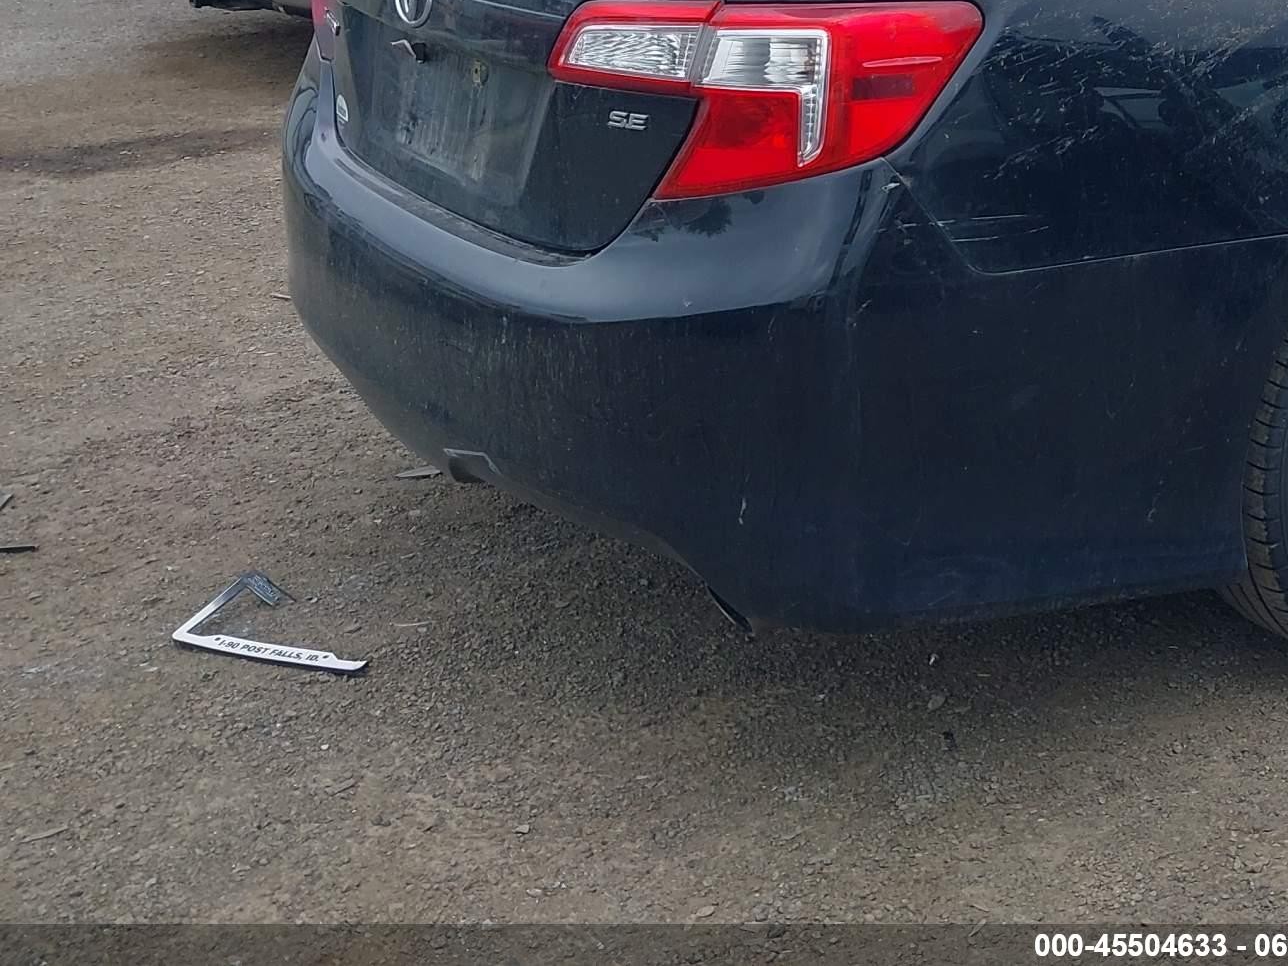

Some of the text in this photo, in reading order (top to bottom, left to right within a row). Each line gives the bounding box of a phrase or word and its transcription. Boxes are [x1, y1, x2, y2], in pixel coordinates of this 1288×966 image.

[608, 110, 649, 131] SE
[240, 644, 269, 654] POST
[269, 649, 302, 660] FALLS,
